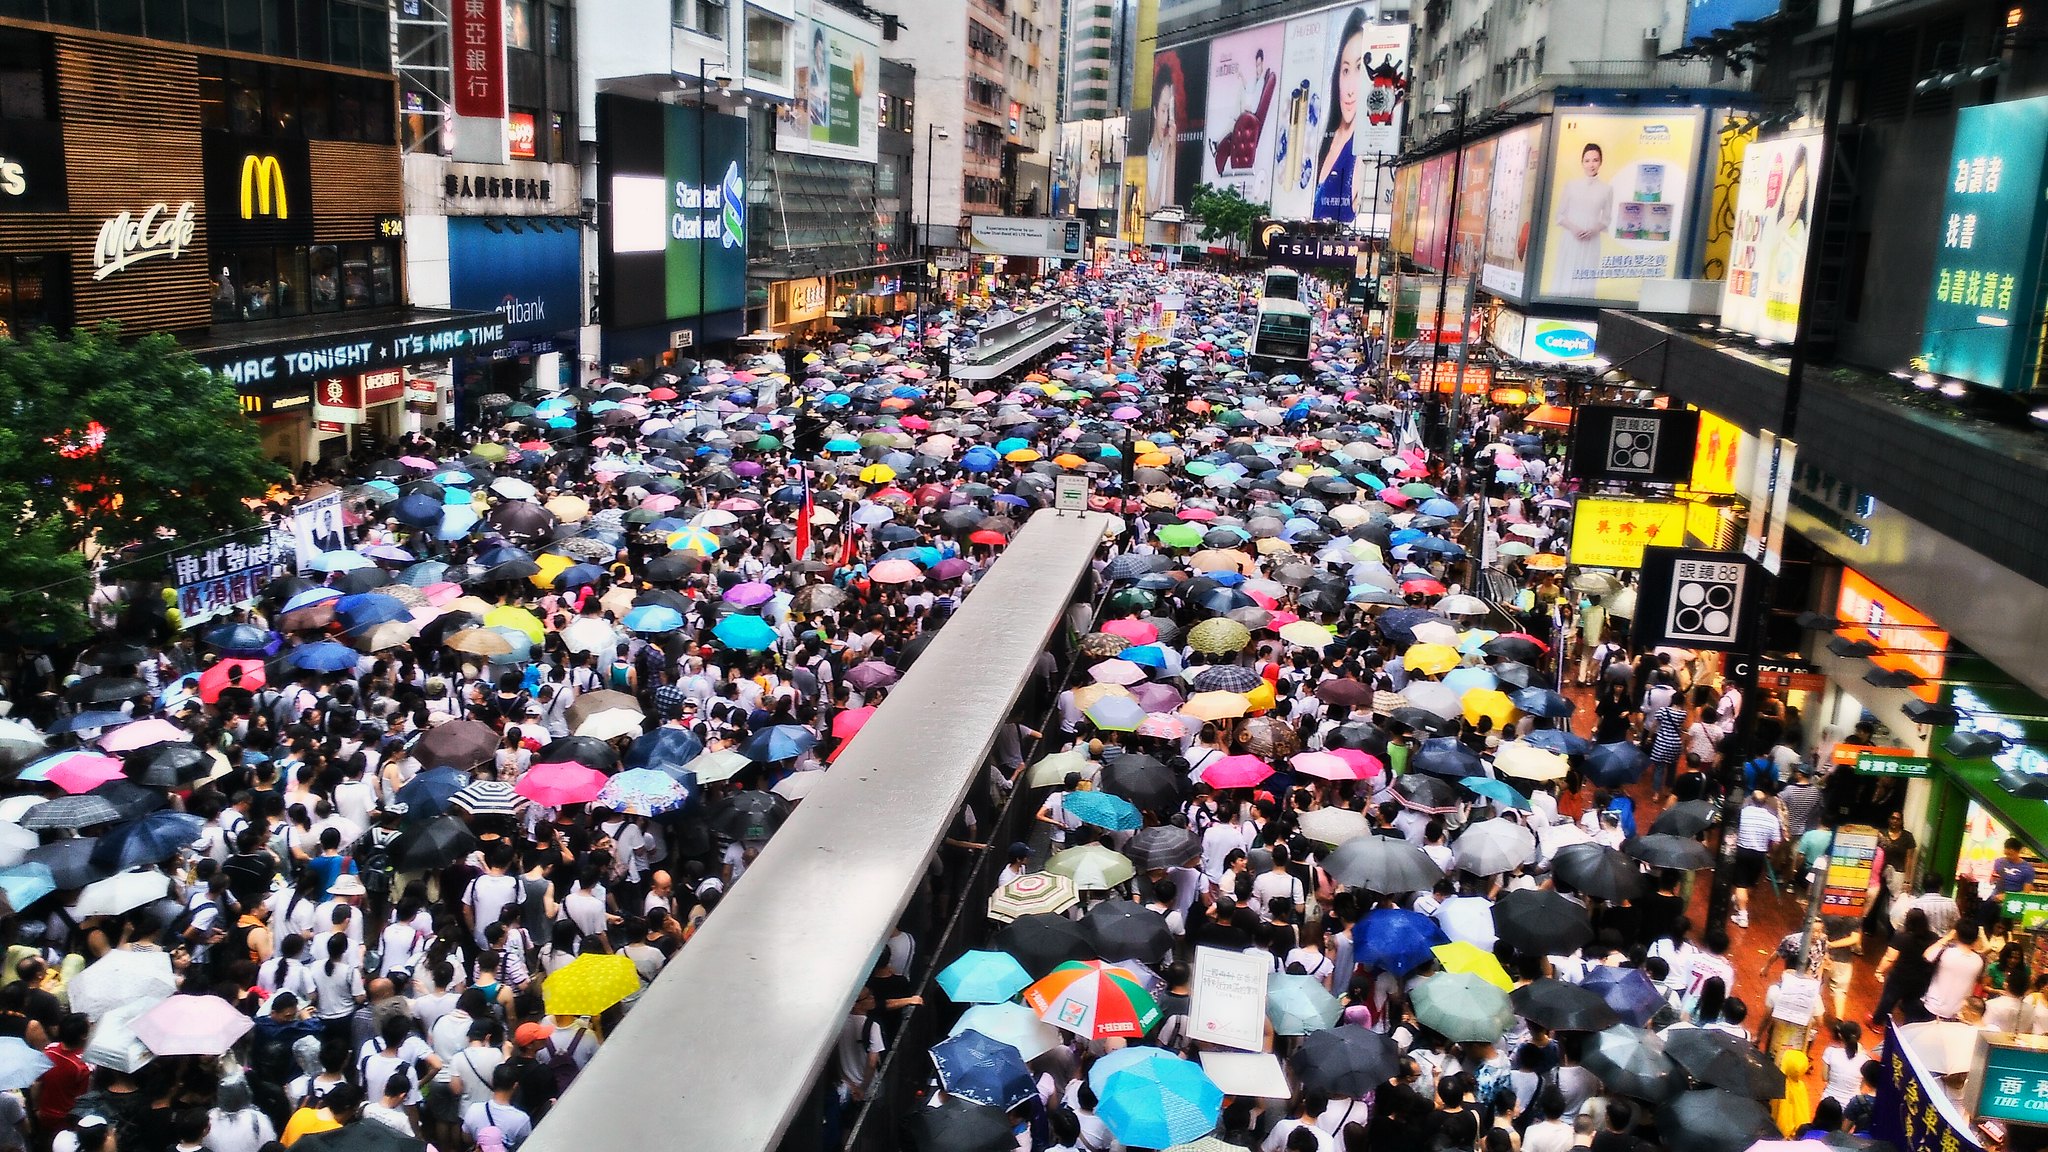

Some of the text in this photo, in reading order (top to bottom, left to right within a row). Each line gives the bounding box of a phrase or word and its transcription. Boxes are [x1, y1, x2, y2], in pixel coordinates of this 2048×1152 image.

[464, 0, 489, 98] 東亞銀行
[1279, 244, 1314, 256] TSL
[284, 342, 372, 376] TONIGHT
[394, 333, 425, 359] IT'S
[429, 329, 465, 354] MAC
[469, 324, 504, 347] TIME
[1545, 335, 1590, 352] Cetaphil
[1691, 970, 1704, 995] 7
[1993, 1096, 2021, 1108] THE
